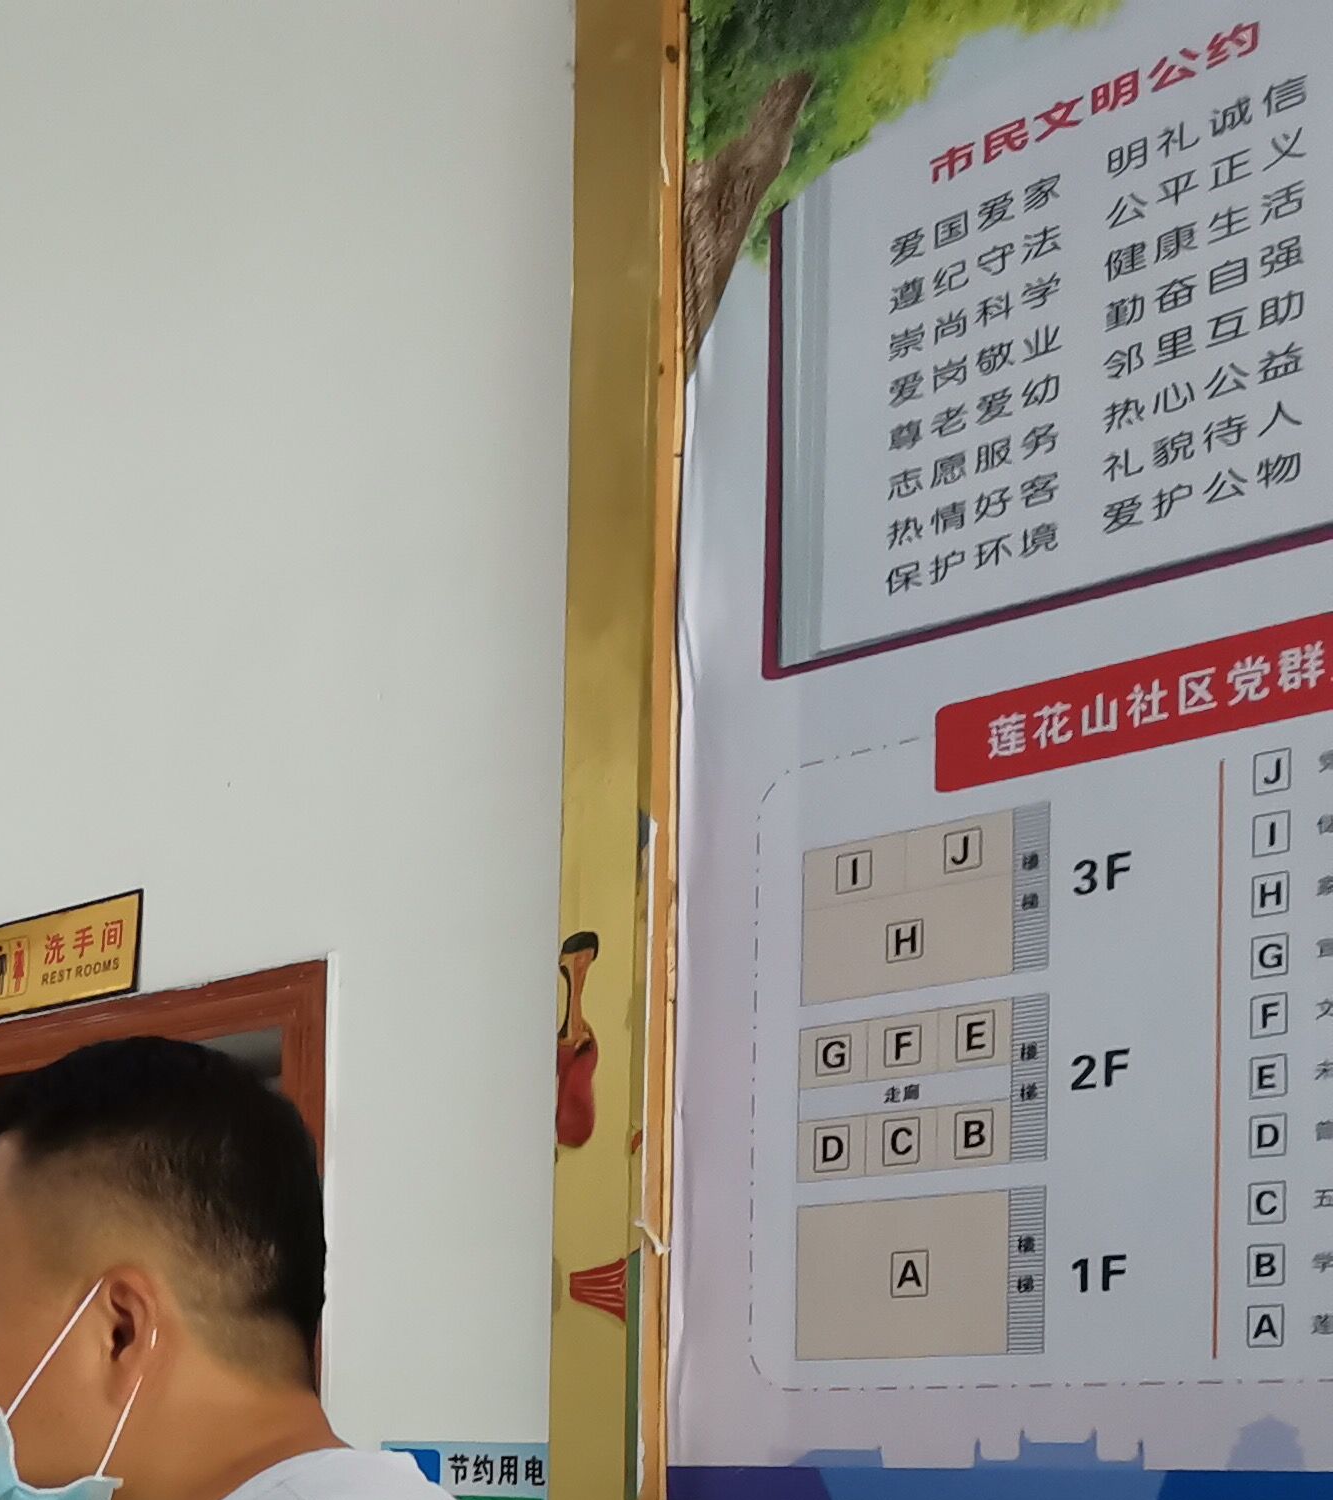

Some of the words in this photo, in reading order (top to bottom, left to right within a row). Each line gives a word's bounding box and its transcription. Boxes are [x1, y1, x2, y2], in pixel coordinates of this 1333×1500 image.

[930, 21, 1260, 184] 市民文明公约
[1107, 74, 1308, 178] 明礼诚信
[1107, 127, 1307, 231] 公平正义
[890, 173, 1061, 266] 爱国爱家
[1105, 180, 1305, 283] 健康生活
[889, 226, 1061, 315] 遵纪守法
[1105, 235, 1304, 333] 勤奋自强
[889, 272, 1061, 362] 崇尚科学
[1103, 290, 1304, 380] 邻里互助
[889, 325, 1062, 407] 爱岗敬业
[1103, 343, 1303, 433] 热心公益
[889, 374, 1060, 454] 尊老爱幼
[1102, 401, 1302, 482] 礼貌待人
[888, 422, 1058, 501] 志愿服务
[887, 472, 1058, 550] 热情好客
[1102, 452, 1301, 536] 爱护公物
[886, 522, 1058, 597] 保护环境
[1264, 758, 1282, 784] J
[951, 834, 968, 865] J
[1074, 852, 1131, 896] 3F
[1260, 881, 1282, 908] H
[44, 919, 123, 965] 洗手间
[894, 926, 916, 955] H
[1259, 943, 1282, 968] G
[41, 968, 71, 987] REST
[75, 957, 119, 979] ROOMS
[1261, 1002, 1280, 1029] F
[894, 1031, 913, 1061] F
[966, 1020, 985, 1051] E
[823, 1042, 845, 1069] G
[1071, 1049, 1130, 1091] 2F
[1257, 1063, 1277, 1089] E
[823, 1135, 844, 1163] D
[891, 1127, 913, 1155] C
[964, 1121, 985, 1149] B
[1257, 1124, 1278, 1149] D
[1256, 1190, 1277, 1215] C
[897, 1259, 921, 1288] A
[1071, 1255, 1126, 1294] 1F
[1256, 1253, 1275, 1278] B
[1253, 1314, 1277, 1340] A
[448, 1453, 545, 1486] 节约用电
